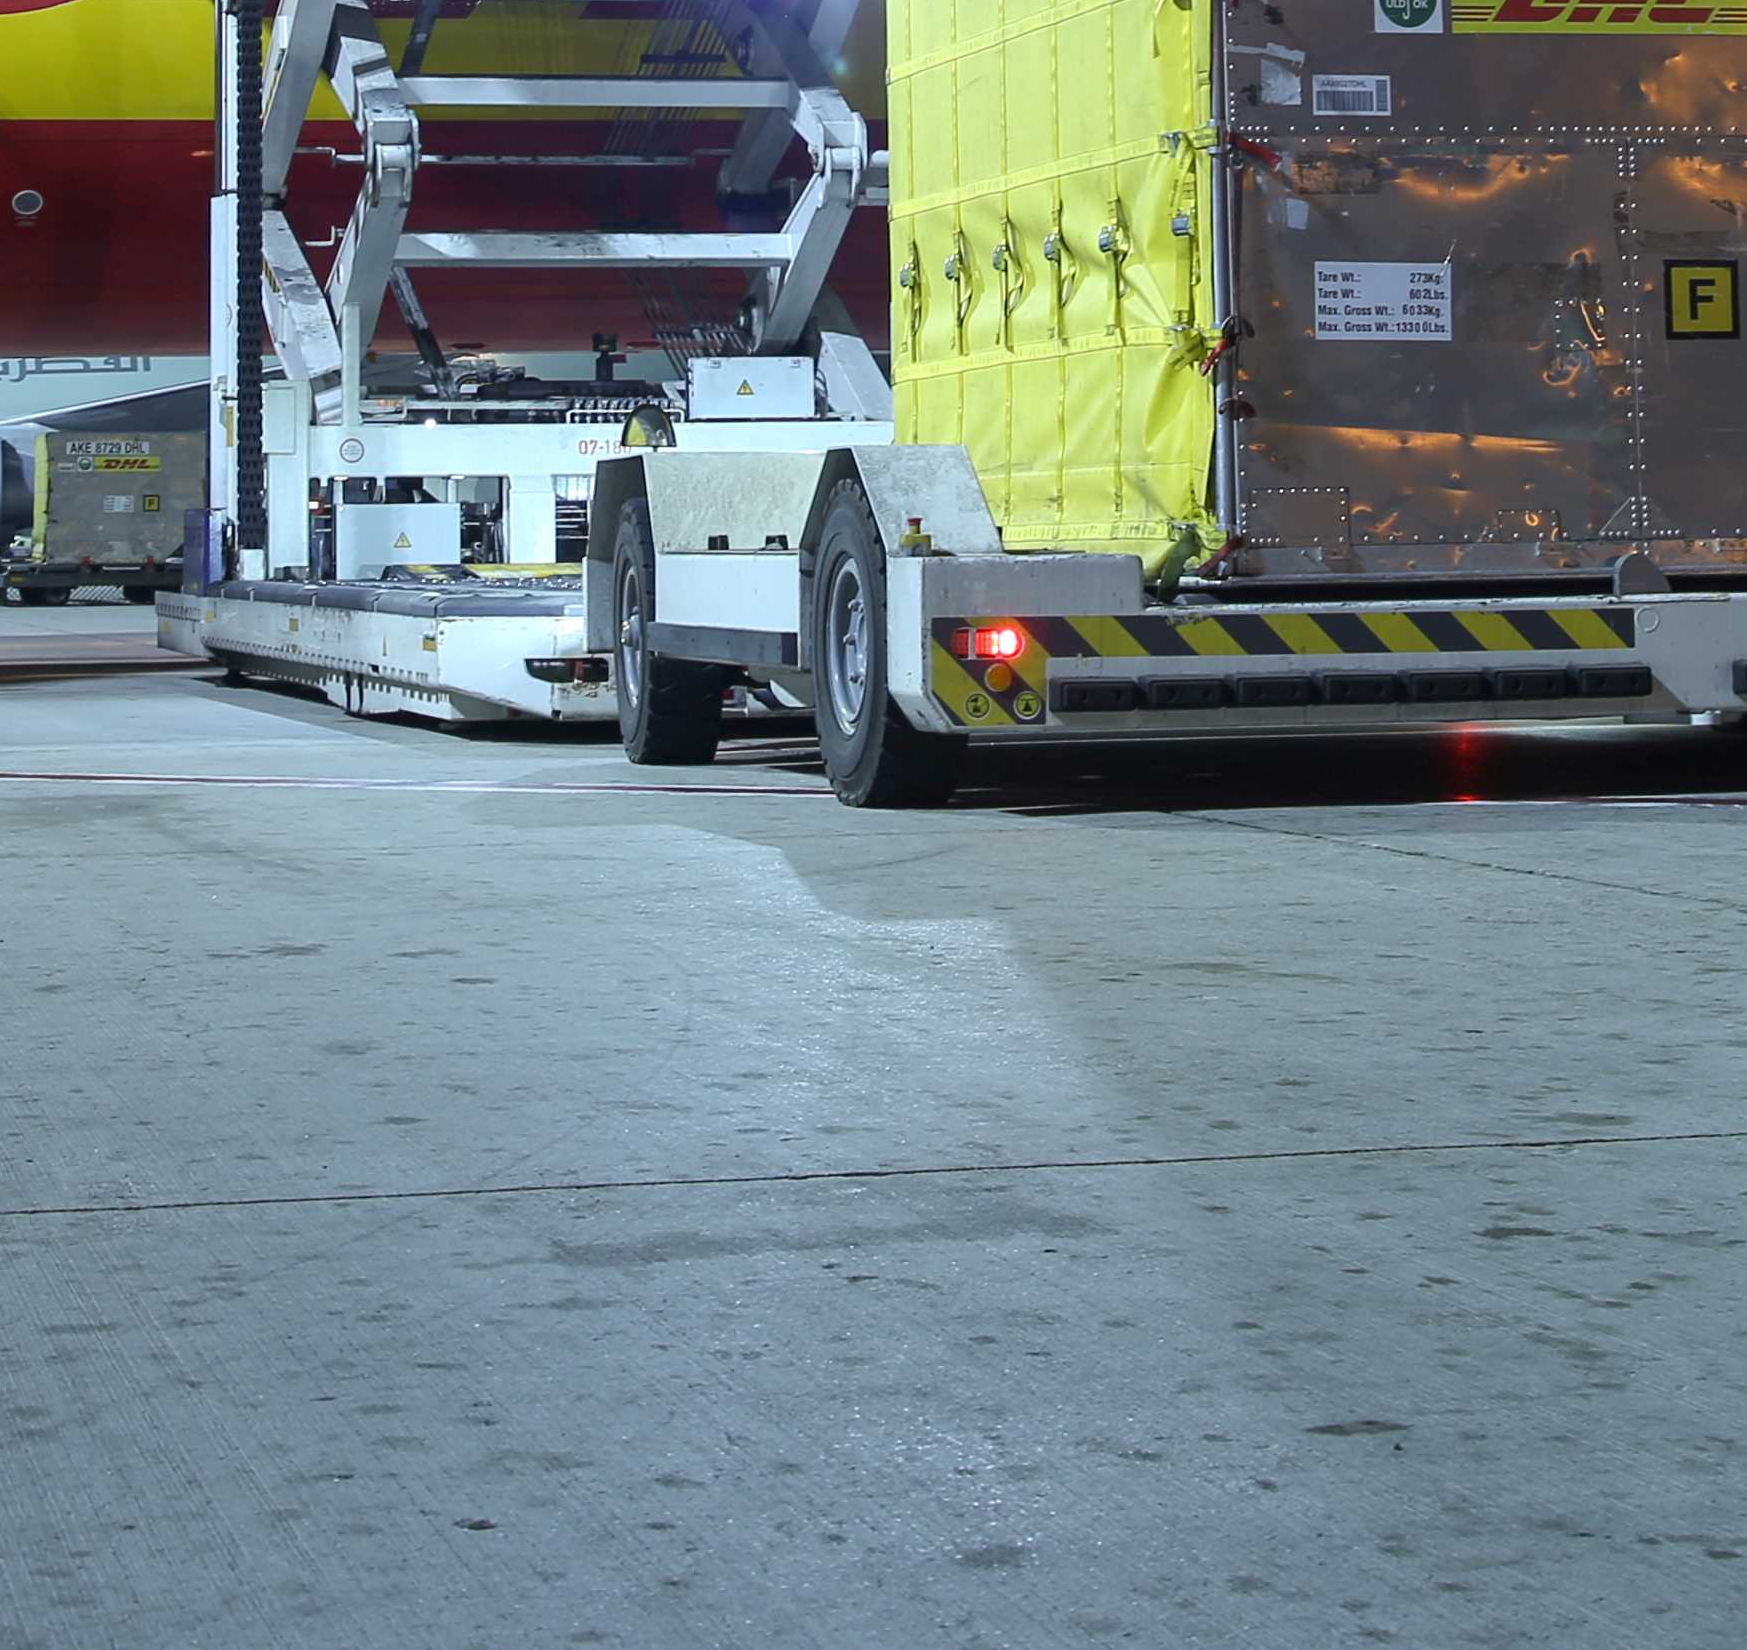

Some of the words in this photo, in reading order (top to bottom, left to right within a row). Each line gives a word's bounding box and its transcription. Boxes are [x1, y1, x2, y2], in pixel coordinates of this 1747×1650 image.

[1413, 0, 1428, 9] OK
[1318, 271, 1338, 282] Tare
[1318, 288, 1338, 299] Tare
[1688, 278, 1715, 321] F
[1318, 305, 1342, 315] Max.
[1344, 305, 1372, 316] Gross
[1318, 321, 1342, 332] Max.
[1344, 321, 1372, 332] Gross
[70, 442, 91, 453] AKE
[125, 442, 146, 454] DHL
[103, 458, 151, 470] DHL
[147, 498, 156, 508] F
